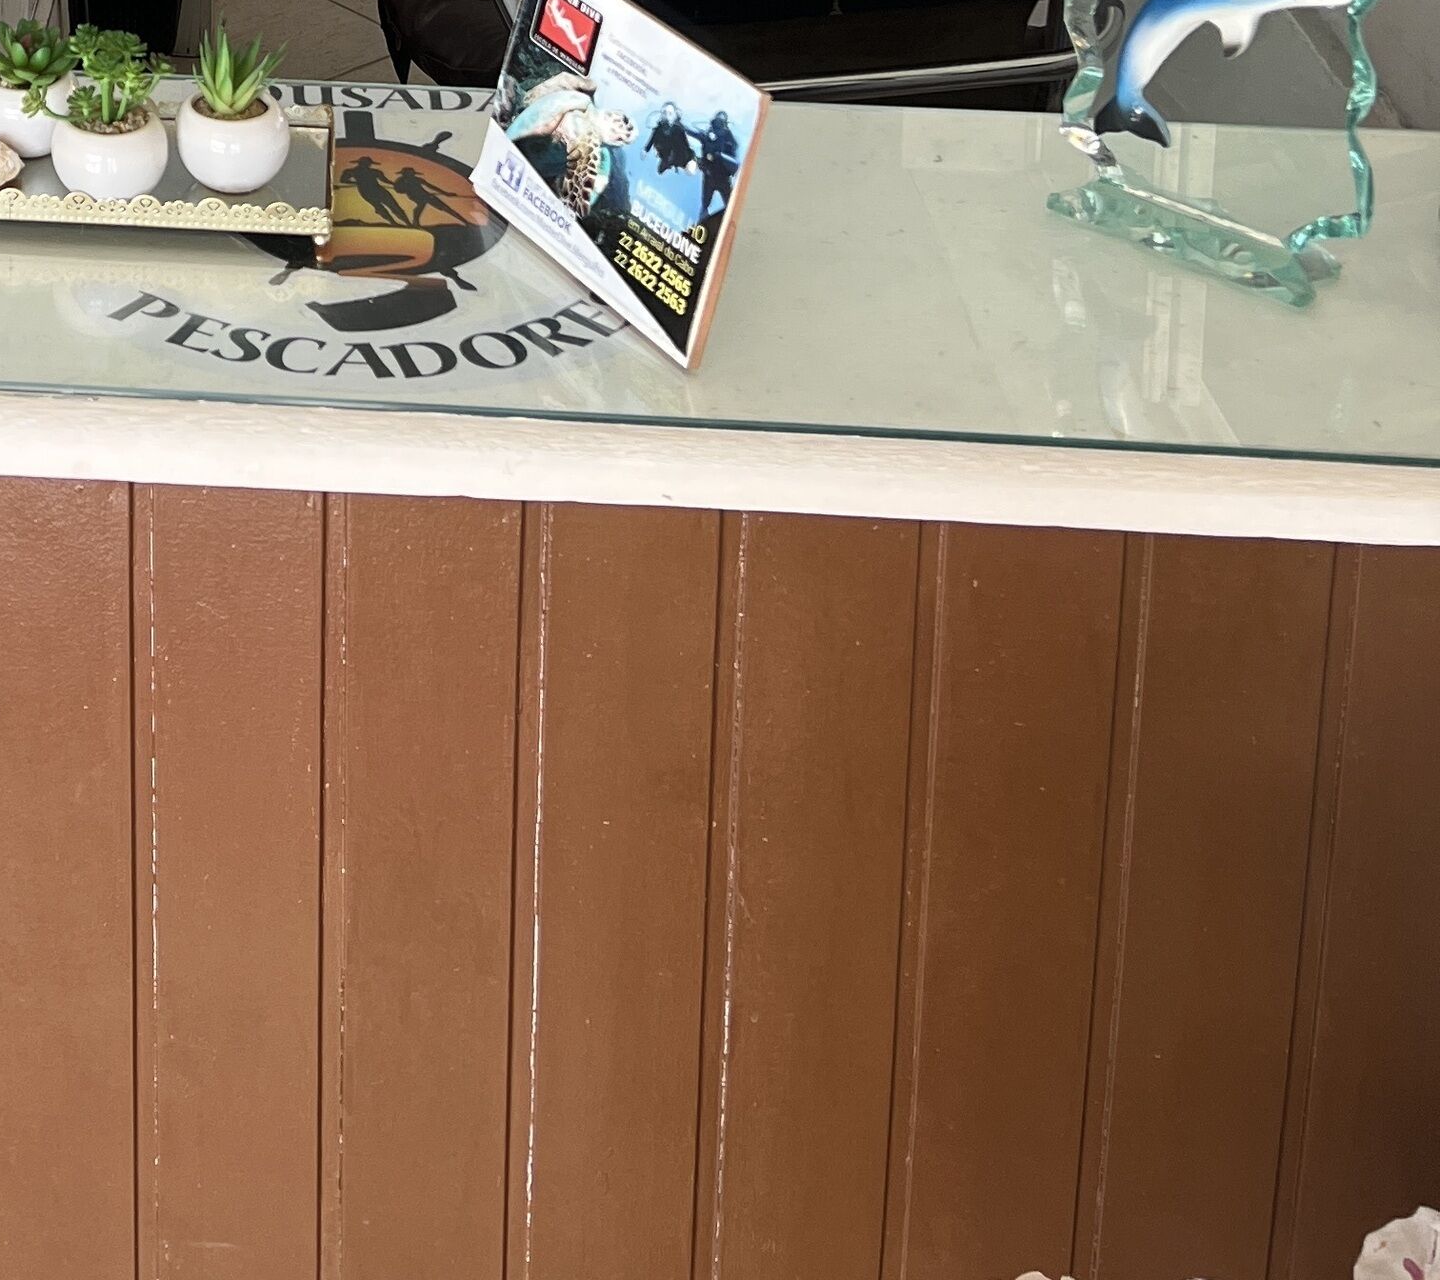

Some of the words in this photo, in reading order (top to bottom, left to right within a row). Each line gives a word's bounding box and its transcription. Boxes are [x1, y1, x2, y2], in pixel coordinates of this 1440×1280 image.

[580, 3, 601, 23] DIVE
[523, 187, 572, 231] FACEBOOK
[614, 249, 627, 269] 22
[626, 258, 658, 292] 2622
[655, 281, 688, 316] 2563
[618, 232, 632, 251] 22
[632, 241, 663, 274] 2622
[661, 264, 693, 297] 2565
[107, 290, 632, 380] PESCADORE
